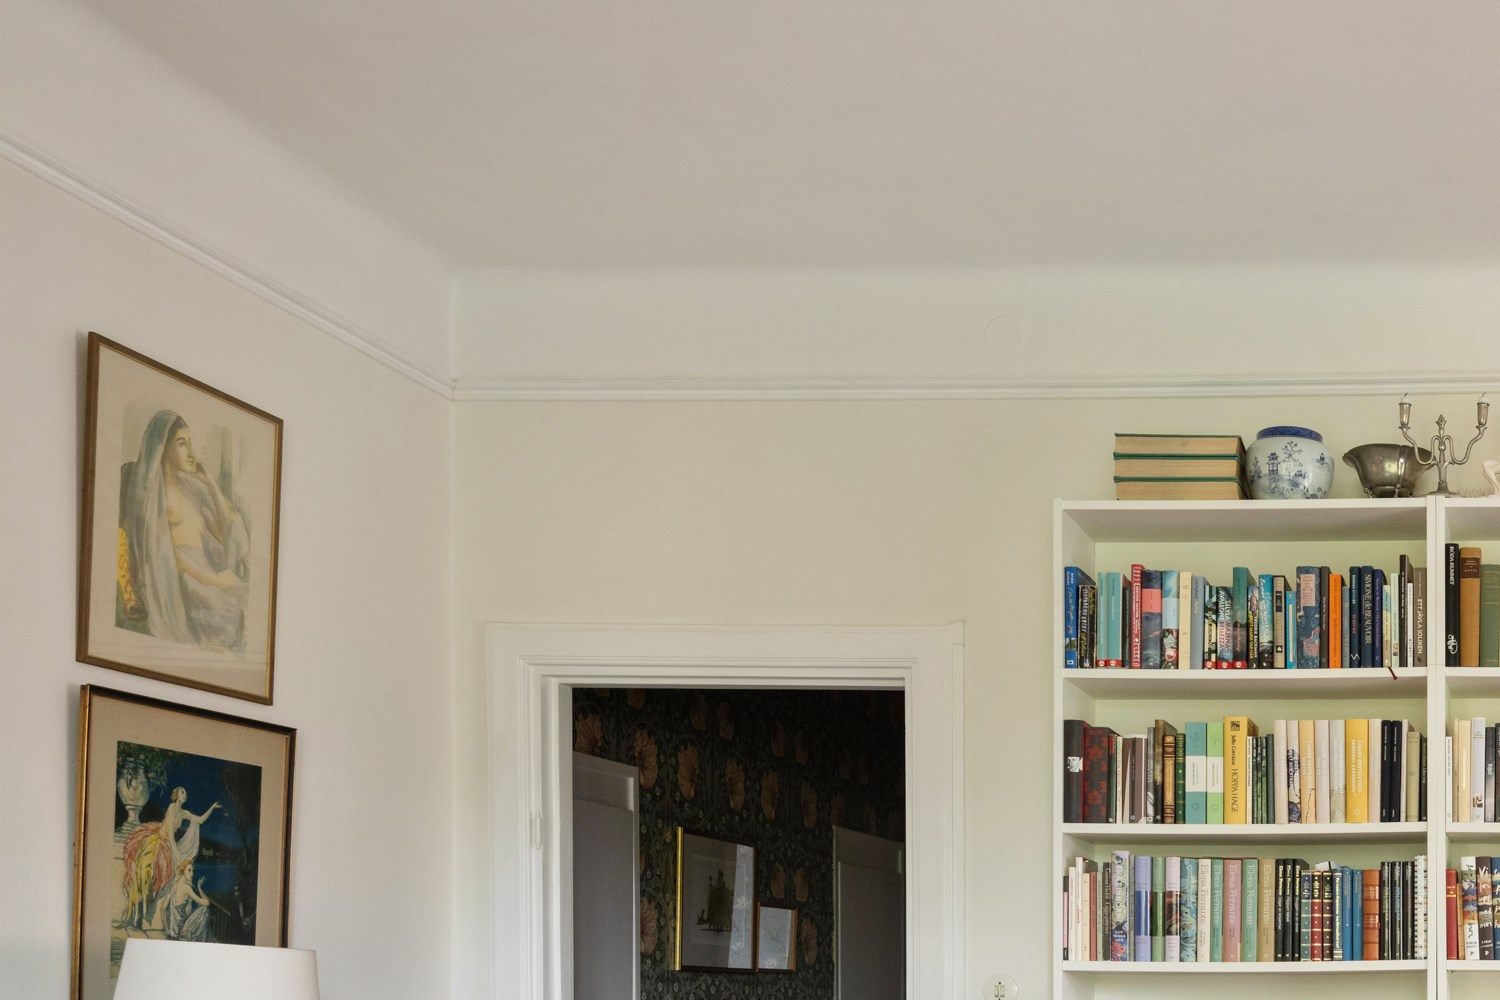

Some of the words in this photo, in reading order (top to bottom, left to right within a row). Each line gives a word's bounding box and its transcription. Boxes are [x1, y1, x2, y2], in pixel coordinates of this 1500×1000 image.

[1365, 601, 1372, 610] de
[1214, 865, 1222, 888] Elena
[1230, 865, 1238, 888] Elena
[1246, 865, 1255, 888] Elena
[1263, 865, 1272, 888] Elena
[1479, 866, 1490, 876] Vi
[1214, 889, 1222, 924] Ferrante
[1230, 889, 1238, 924] Ferrante
[1246, 889, 1255, 924] Ferrante
[1263, 889, 1272, 924] Ferrante
